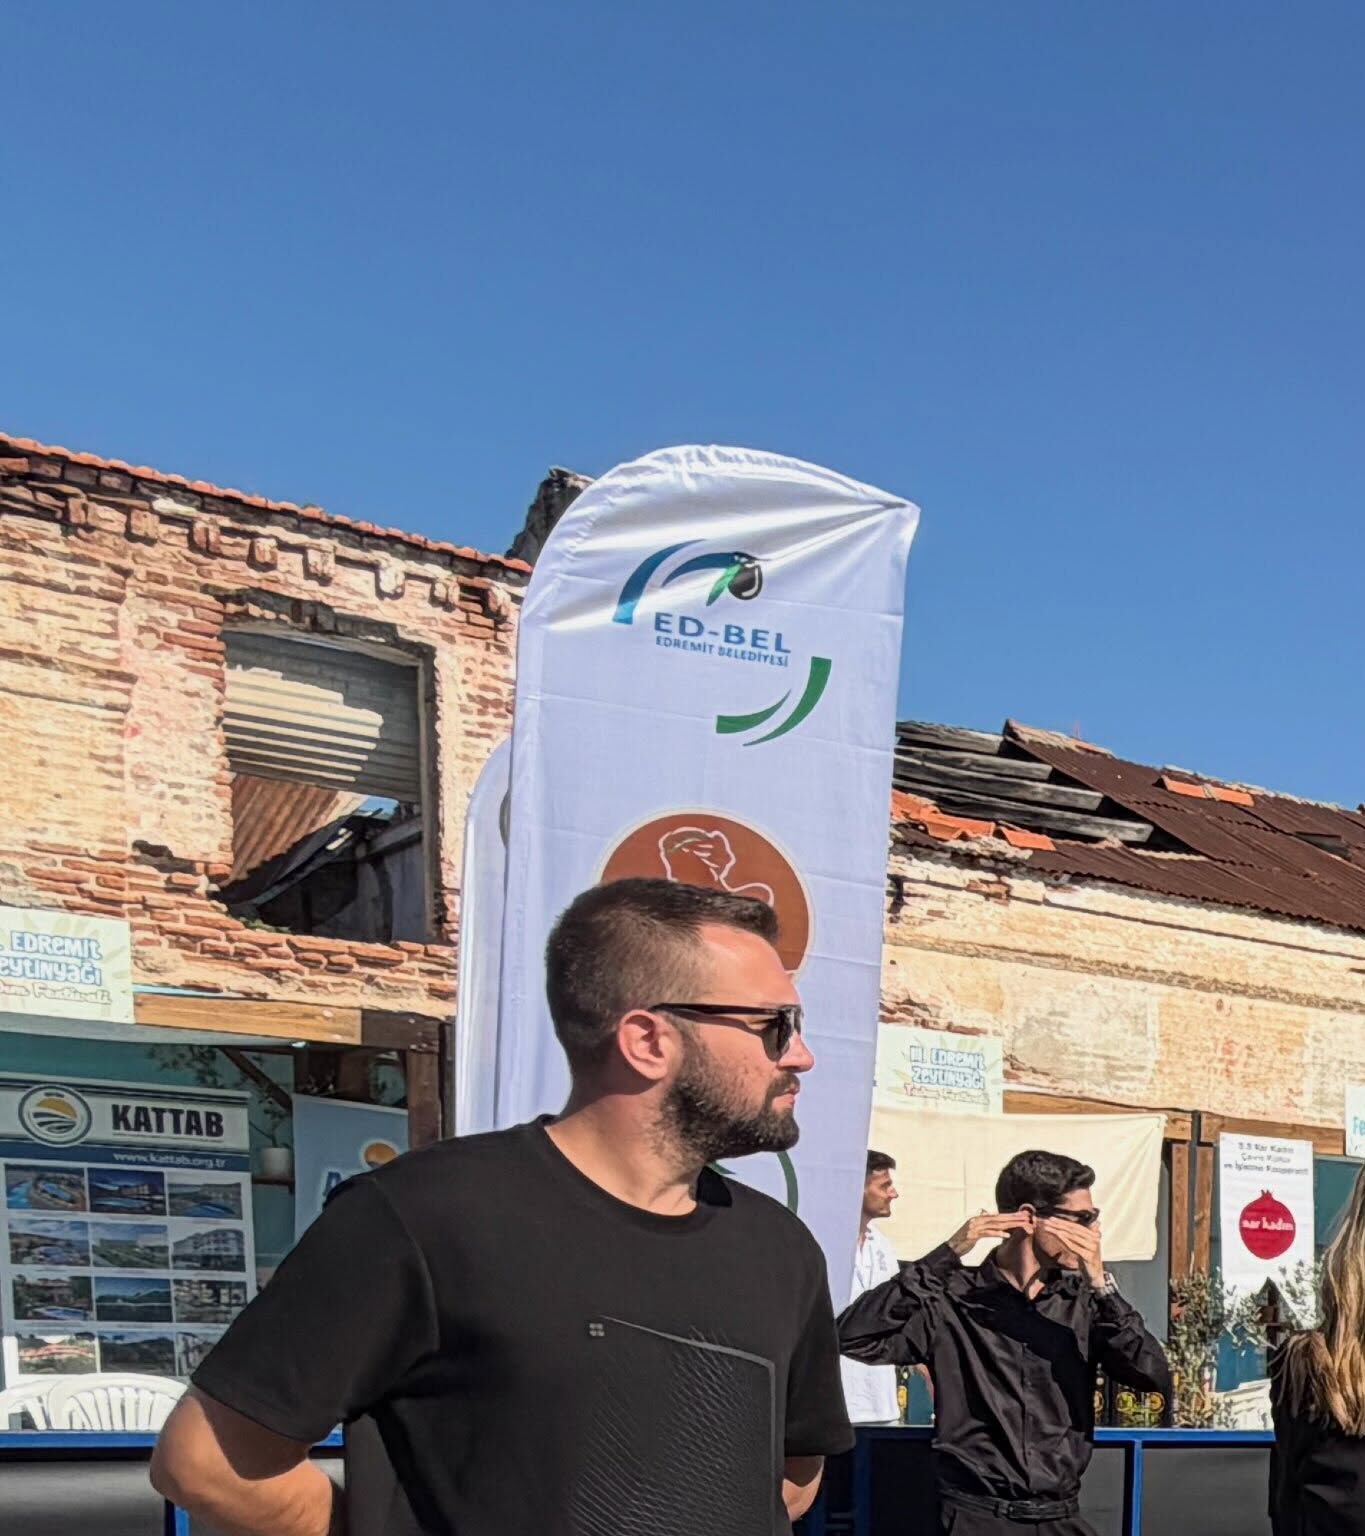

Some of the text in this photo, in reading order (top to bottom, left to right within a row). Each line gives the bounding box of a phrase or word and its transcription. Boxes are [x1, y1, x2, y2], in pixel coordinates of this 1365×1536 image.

[654, 611, 792, 654] ED-BEL
[111, 1103, 225, 1138] KATTAB
[112, 1151, 226, 1169] www.kattab.org.tr
